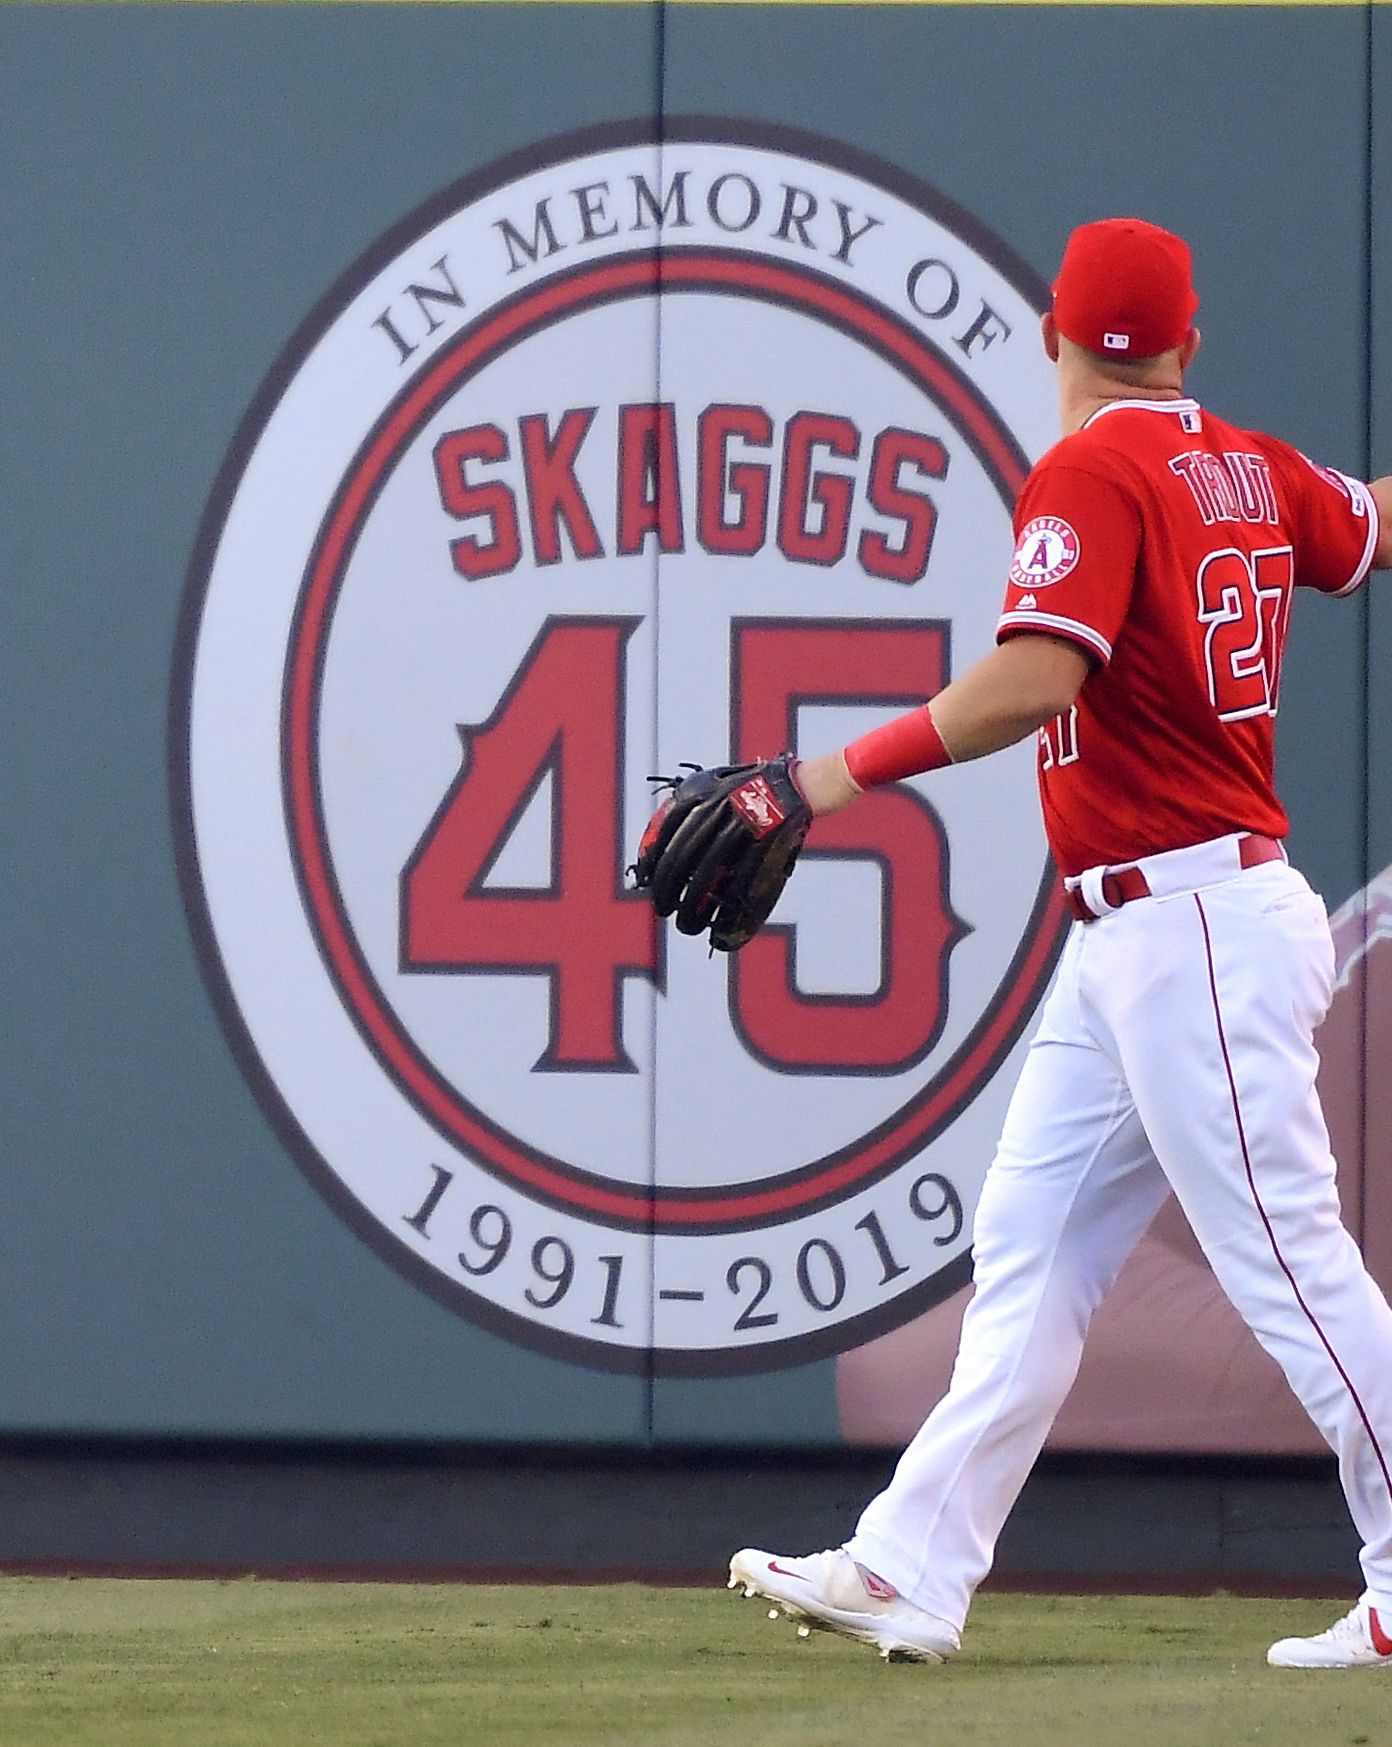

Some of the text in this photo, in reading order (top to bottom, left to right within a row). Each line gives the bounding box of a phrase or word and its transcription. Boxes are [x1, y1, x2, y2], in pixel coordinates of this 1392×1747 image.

[372, 169, 1013, 366] IN MEMORY OF
[433, 401, 950, 586] SKAGGS
[1198, 545, 1294, 722] 27
[399, 614, 976, 1076] 45
